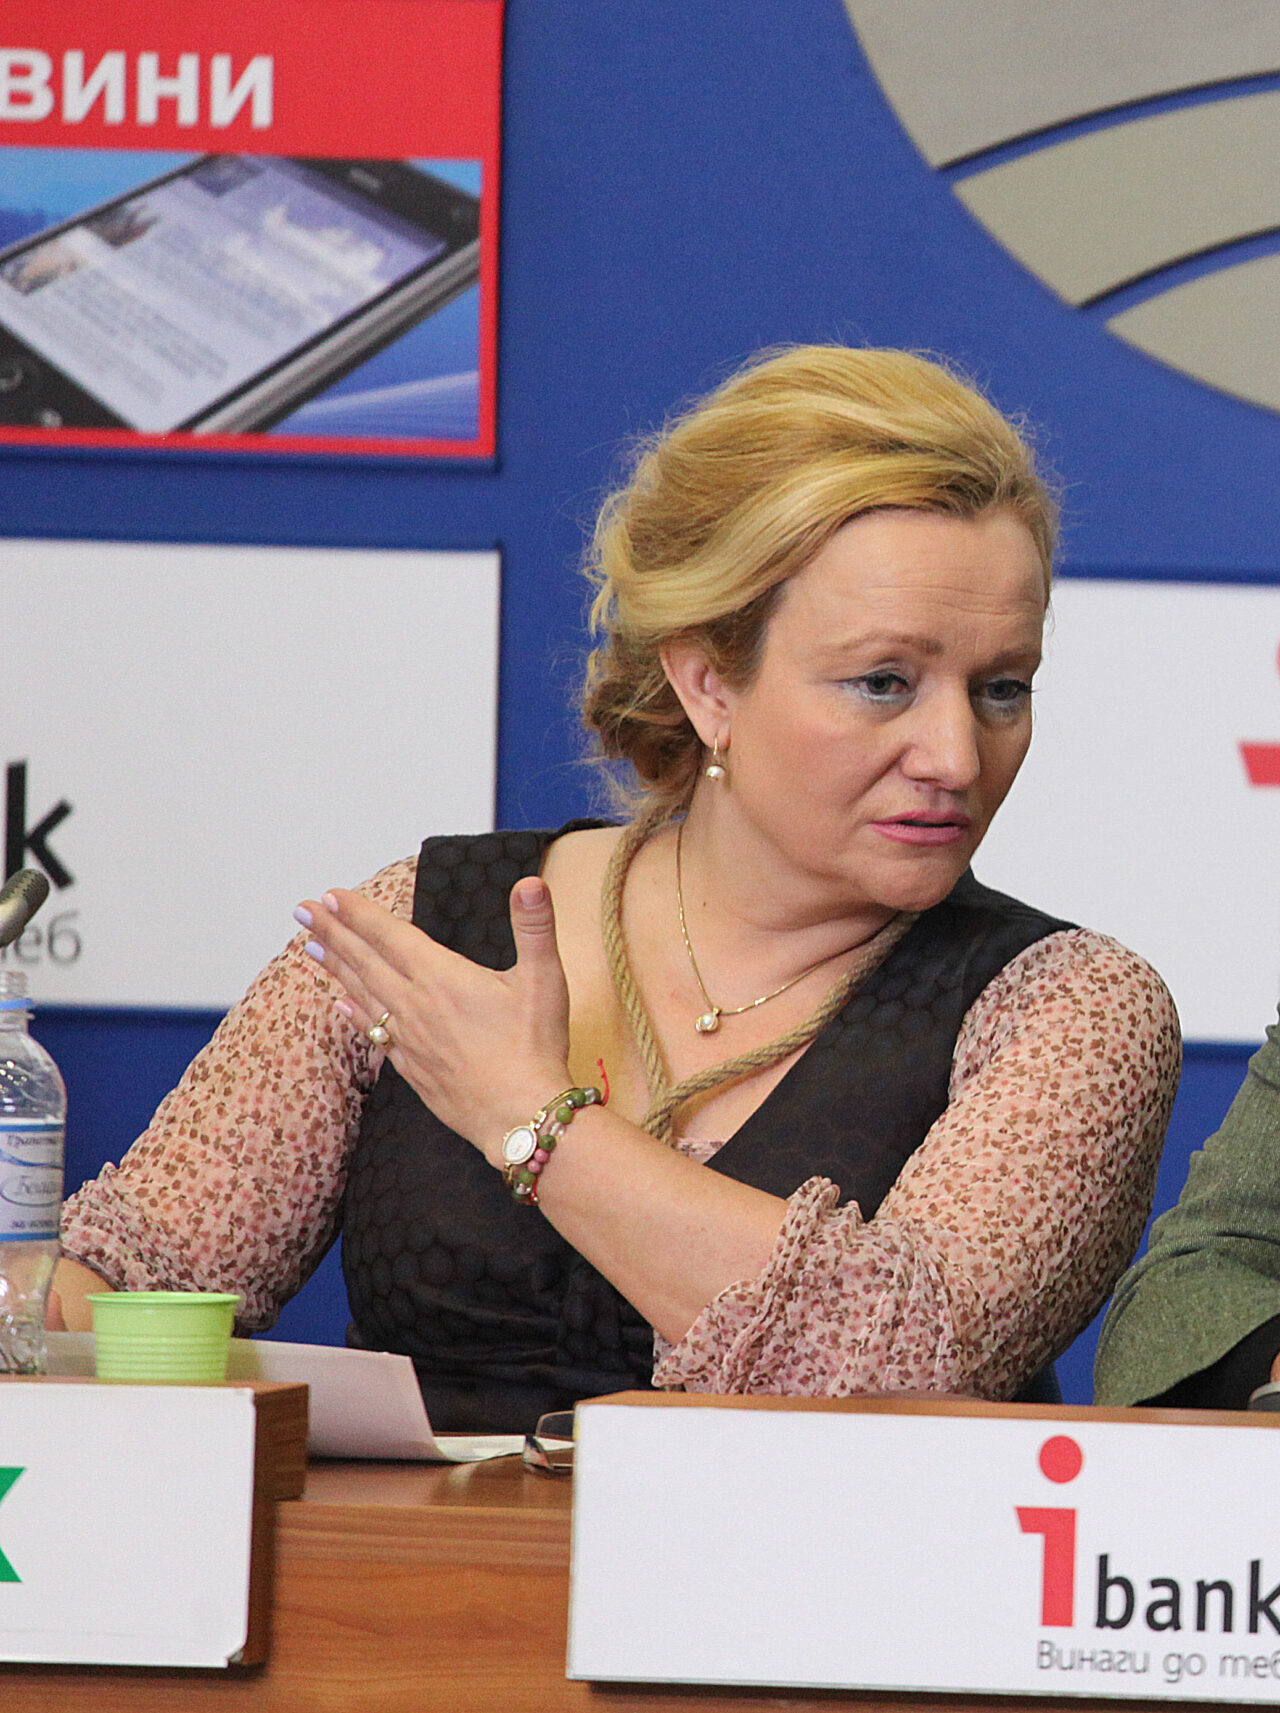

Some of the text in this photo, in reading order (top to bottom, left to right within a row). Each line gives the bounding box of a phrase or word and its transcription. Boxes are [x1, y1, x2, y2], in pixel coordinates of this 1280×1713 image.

[0, 47, 274, 129] ВИНИ
[1036, 1640, 1149, 1674] Винаги
[1162, 1652, 1206, 1683] до
